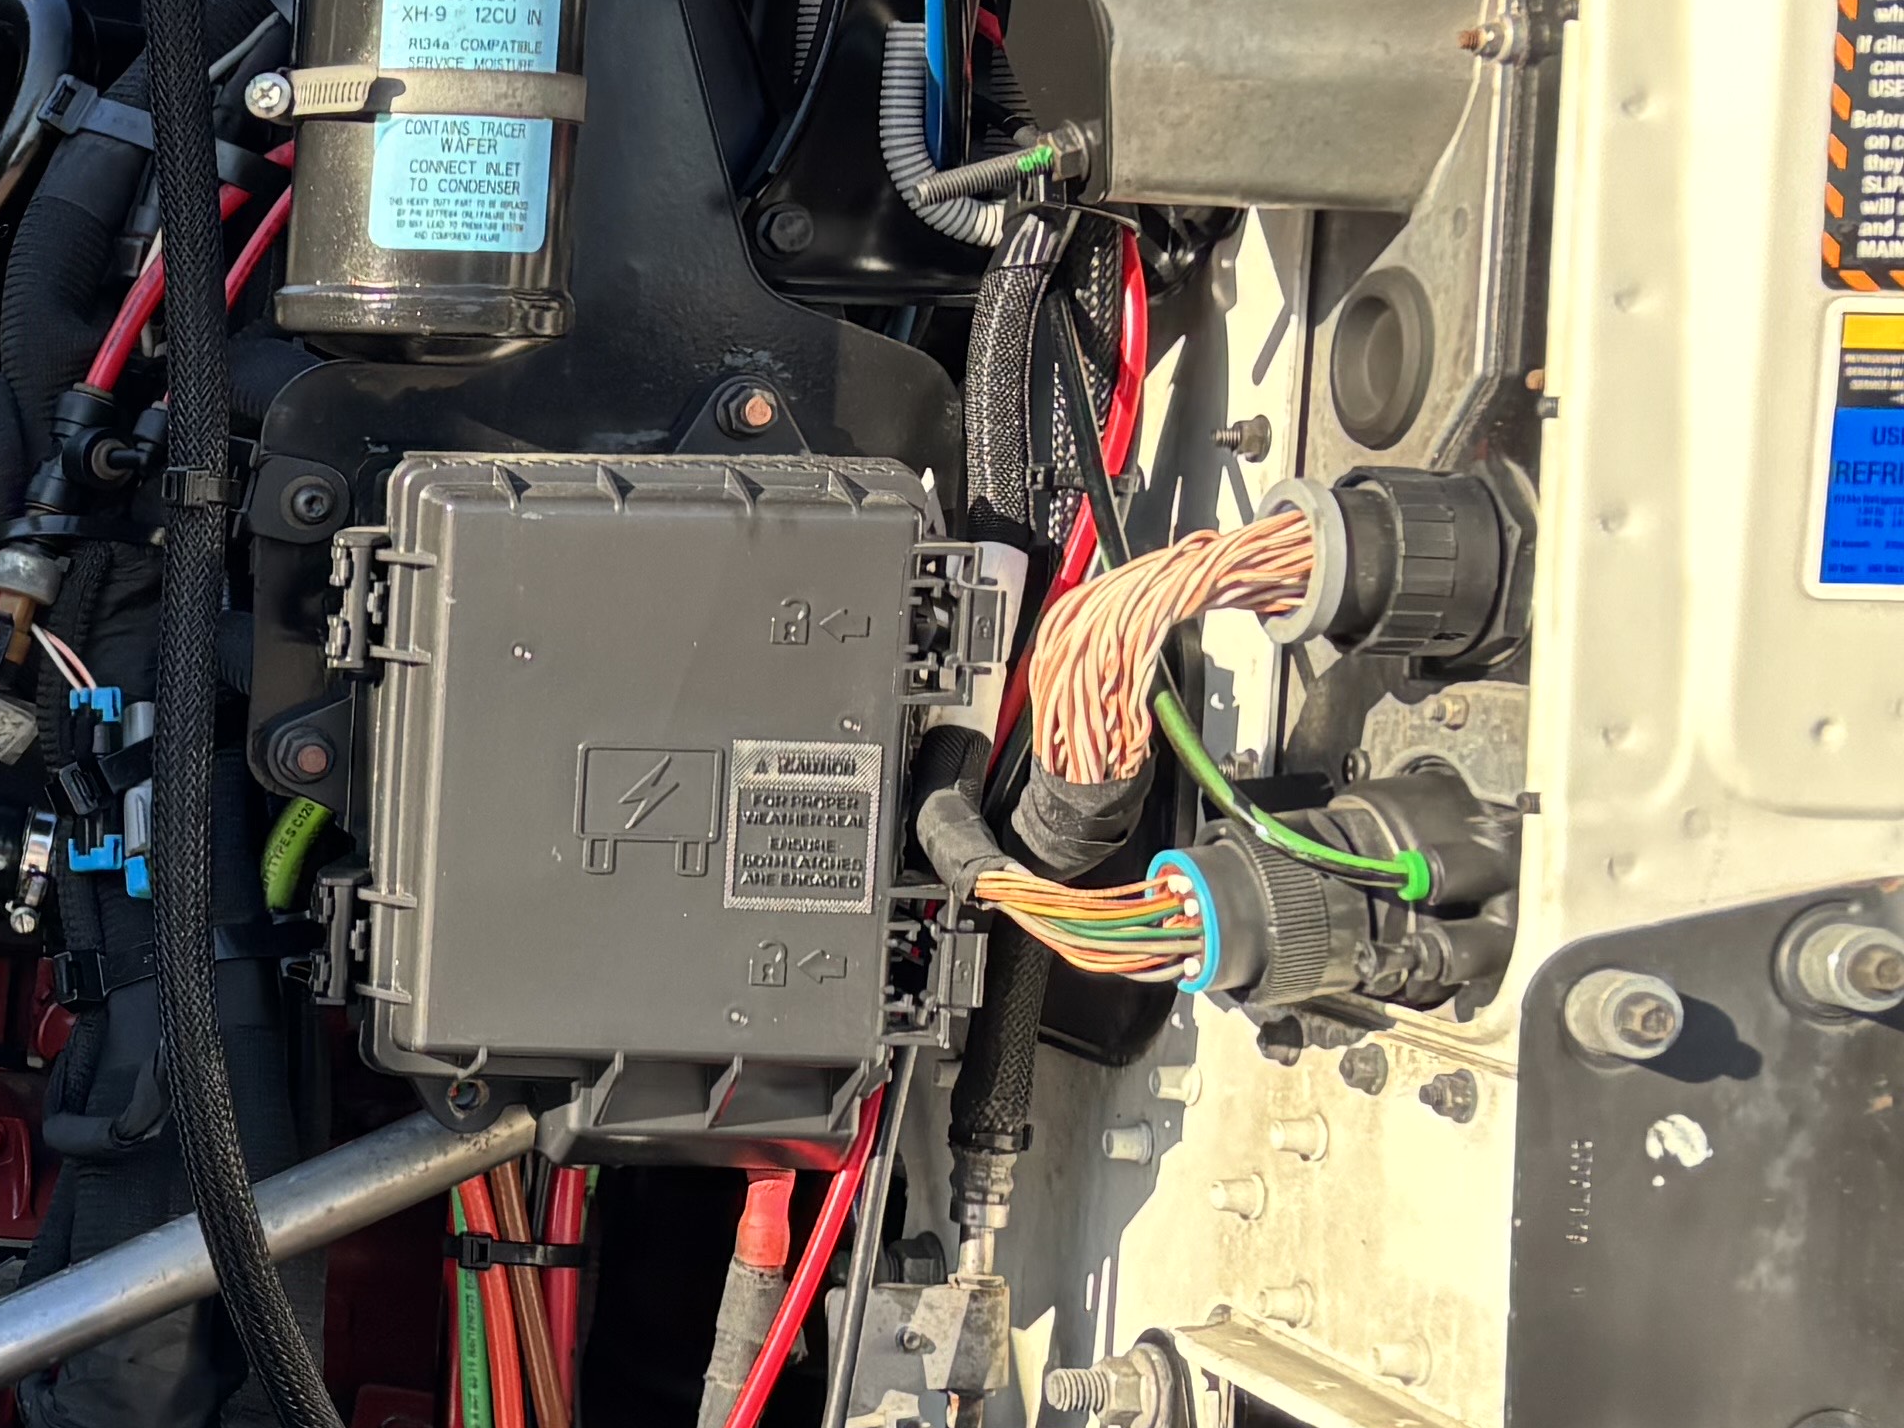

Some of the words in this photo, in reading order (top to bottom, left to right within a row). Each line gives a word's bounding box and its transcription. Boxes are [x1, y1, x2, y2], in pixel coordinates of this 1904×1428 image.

[476, 7, 516, 24] 12CU
[405, 119, 470, 136] CONTAINS
[480, 121, 526, 139] TRACER
[441, 137, 498, 155] WAFER
[409, 159, 477, 175] CONNECT
[485, 161, 520, 177] INLET
[409, 177, 428, 192] TO
[438, 178, 520, 196] CONDENSER
